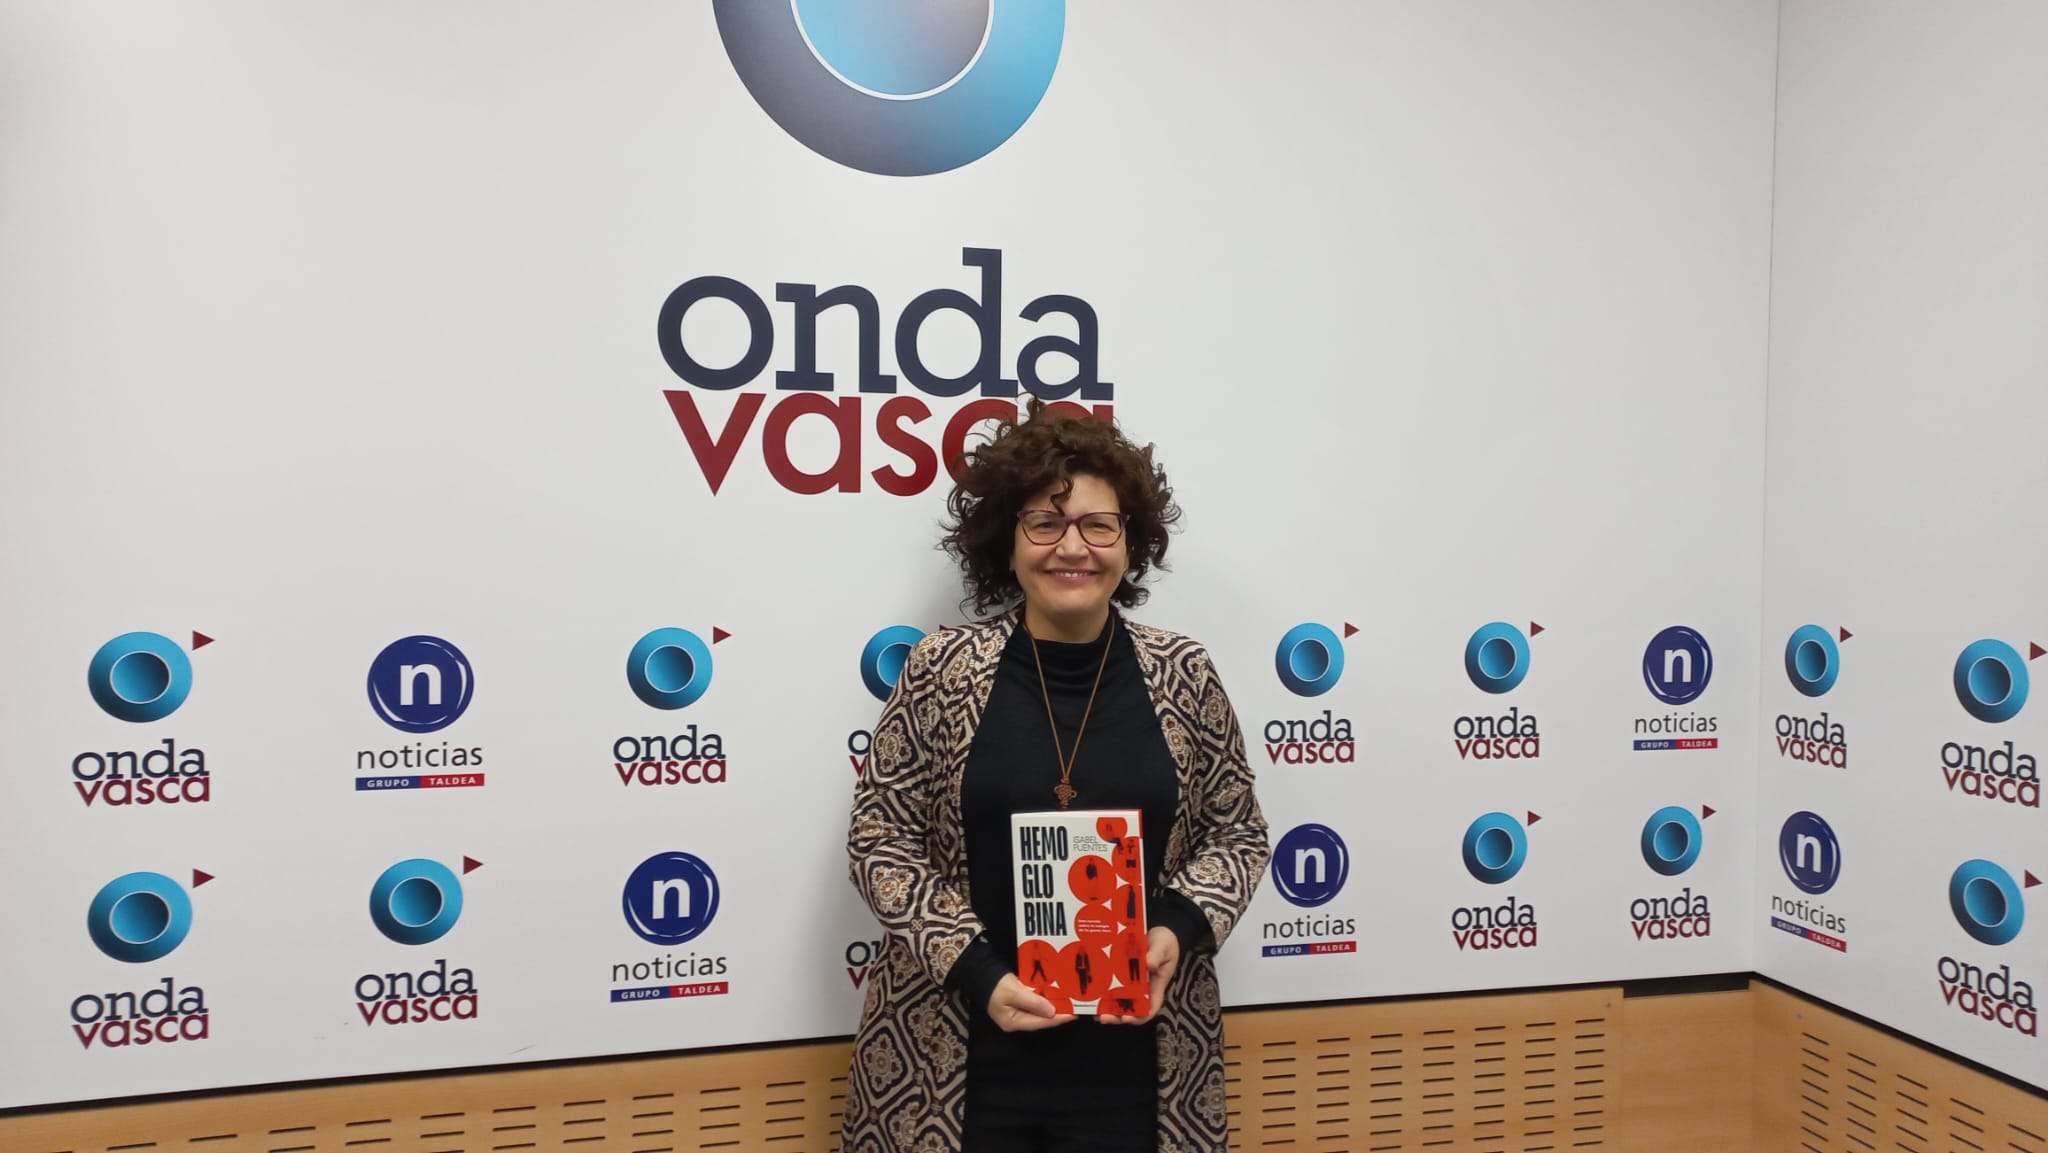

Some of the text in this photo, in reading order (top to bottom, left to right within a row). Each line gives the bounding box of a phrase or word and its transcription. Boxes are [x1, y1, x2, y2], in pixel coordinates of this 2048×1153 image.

[657, 247, 1114, 401] onda
[1264, 710, 1355, 744] onda
[1453, 707, 1539, 739] onda
[1634, 712, 1718, 734] noticias
[1775, 712, 1847, 748] onda
[72, 738, 209, 781] onda
[357, 742, 483, 770] noticias
[613, 725, 726, 763] onda
[1265, 739, 1355, 765] vasca
[1455, 735, 1540, 760] vasca
[1641, 739, 1712, 749] GRUPO TALDEA
[1776, 736, 1848, 770] vasca
[615, 758, 727, 787] vasca
[1941, 741, 2040, 783] onda
[73, 775, 210, 807] vasca
[367, 775, 475, 789] GRUPO TALDEA
[1943, 765, 2042, 808] vasca
[1020, 826, 1068, 861] HEMO
[1072, 835, 1099, 844] ISABEL
[1072, 843, 1108, 852] FUENTES
[1022, 864, 1054, 898] GLO
[1024, 901, 1068, 937] BINA
[1452, 896, 1537, 931] onda
[1630, 888, 1711, 922] onda
[1770, 895, 1846, 933] noticias
[1263, 912, 1357, 941] noticias
[1453, 924, 1538, 951] vasca
[1631, 915, 1711, 942] vasca
[1270, 942, 1352, 956] GRUPO TALDEA
[355, 959, 477, 1002] onda
[612, 952, 728, 984] noticias
[1938, 956, 2037, 1012] onda
[71, 977, 208, 1025] onda
[357, 993, 479, 1026] vasca
[621, 985, 722, 1000] GRUPO TALDEA
[1940, 980, 2038, 1038] vasca
[74, 1013, 210, 1050] vasca
